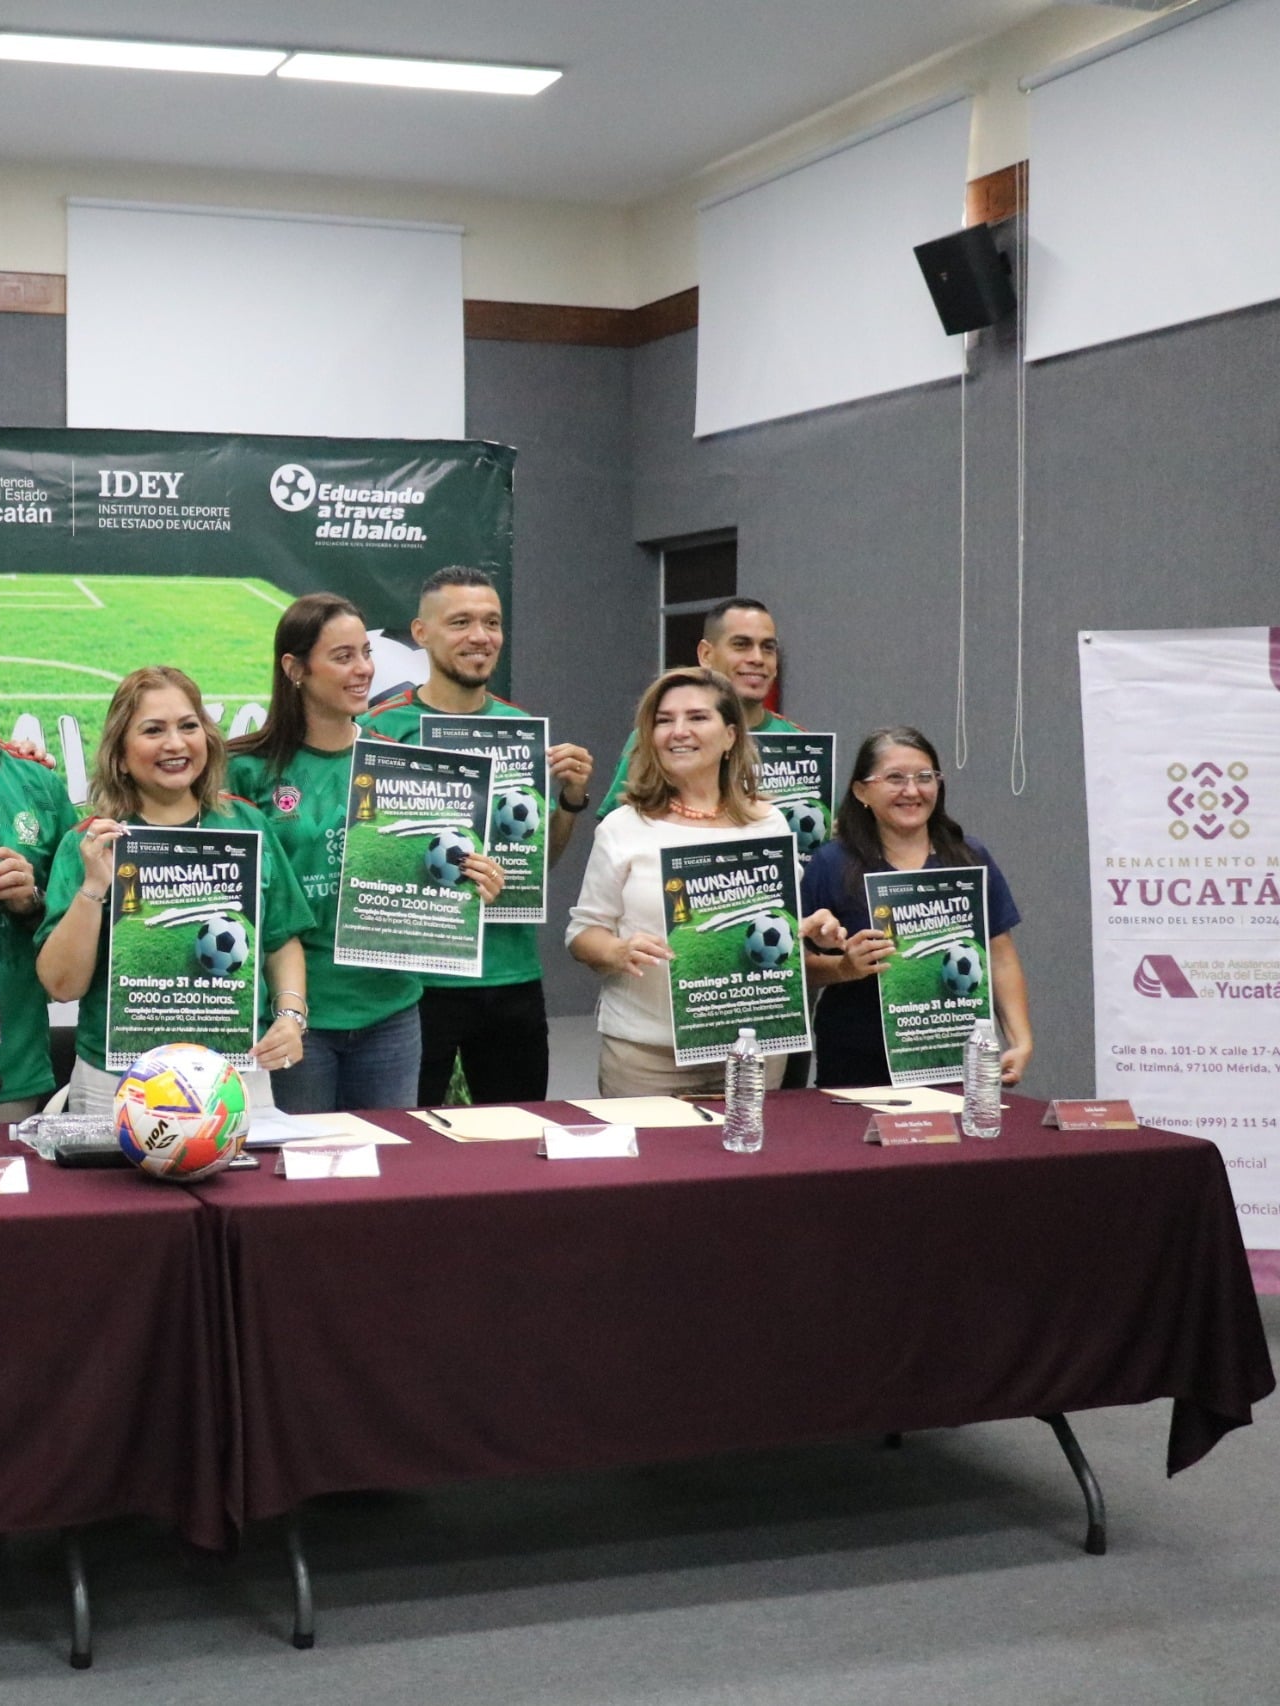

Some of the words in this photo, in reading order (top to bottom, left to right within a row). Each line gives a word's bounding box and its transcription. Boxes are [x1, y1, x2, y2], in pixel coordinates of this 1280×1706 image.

[98, 470, 185, 499] IDEY
[5, 489, 48, 502] Estado
[318, 483, 425, 504] Educando
[98, 504, 157, 516] INSTITUTO
[158, 505, 178, 516] DEL
[181, 506, 230, 517] DEPORTE
[317, 505, 331, 518] a
[335, 501, 405, 520] través
[98, 518, 119, 529] DEL
[121, 518, 164, 529] ESTADO
[166, 519, 180, 530] DE
[182, 518, 231, 531] YUCATÁN
[316, 521, 350, 539] del
[352, 519, 427, 541] balón.
[508, 762, 534, 772] 2026
[445, 800, 474, 810] 2026
[495, 843, 508, 852] de
[510, 842, 538, 854] Mayo
[1106, 856, 1256, 868] RENACIMIENTO
[212, 882, 242, 893] 2026
[350, 877, 403, 894] Domingo
[405, 883, 417, 894] 31
[421, 885, 437, 896] de
[439, 887, 471, 901] Mayo
[755, 881, 782, 894] 2026
[358, 893, 389, 906] 09:00
[400, 898, 428, 910] 12:00
[1108, 916, 1164, 925] GOBIERNO
[1168, 916, 1188, 925] DEL
[1192, 916, 1235, 925] ESTADO
[1181, 960, 1209, 969] Junta
[1211, 960, 1225, 969] de
[678, 976, 729, 989] Domingo
[730, 972, 742, 983] 31
[746, 971, 761, 982] de
[762, 969, 793, 980] Mayo
[1190, 970, 1235, 980] Privada
[1238, 970, 1250, 980] del
[119, 975, 174, 990] Domingo
[176, 976, 189, 987] 31
[193, 976, 210, 988] de
[211, 977, 245, 990] Mayo
[128, 991, 160, 1003] 09:00
[172, 992, 201, 1003] 12:00
[202, 993, 234, 1004] horas.
[688, 990, 718, 1002] 09:00
[728, 986, 754, 998] 12:00
[1200, 986, 1214, 998] de
[1111, 1045, 1137, 1055] Calle
[1140, 1045, 1147, 1055] 8
[1150, 1047, 1167, 1055] no.
[1171, 1046, 1206, 1055] 101-D
[1209, 1046, 1218, 1055] X
[1222, 1046, 1248, 1056] calle
[1115, 1062, 1136, 1072] Col.
[1139, 1063, 1184, 1073] Itzimná,
[1186, 1063, 1223, 1073] 97100
[1226, 1063, 1272, 1073] Mérida,
[1138, 1116, 1193, 1127] Teléfono:
[1195, 1117, 1227, 1128] (999)
[1231, 1117, 1238, 1127] 2
[1243, 1117, 1256, 1127] 11
[1261, 1117, 1276, 1127] 54
